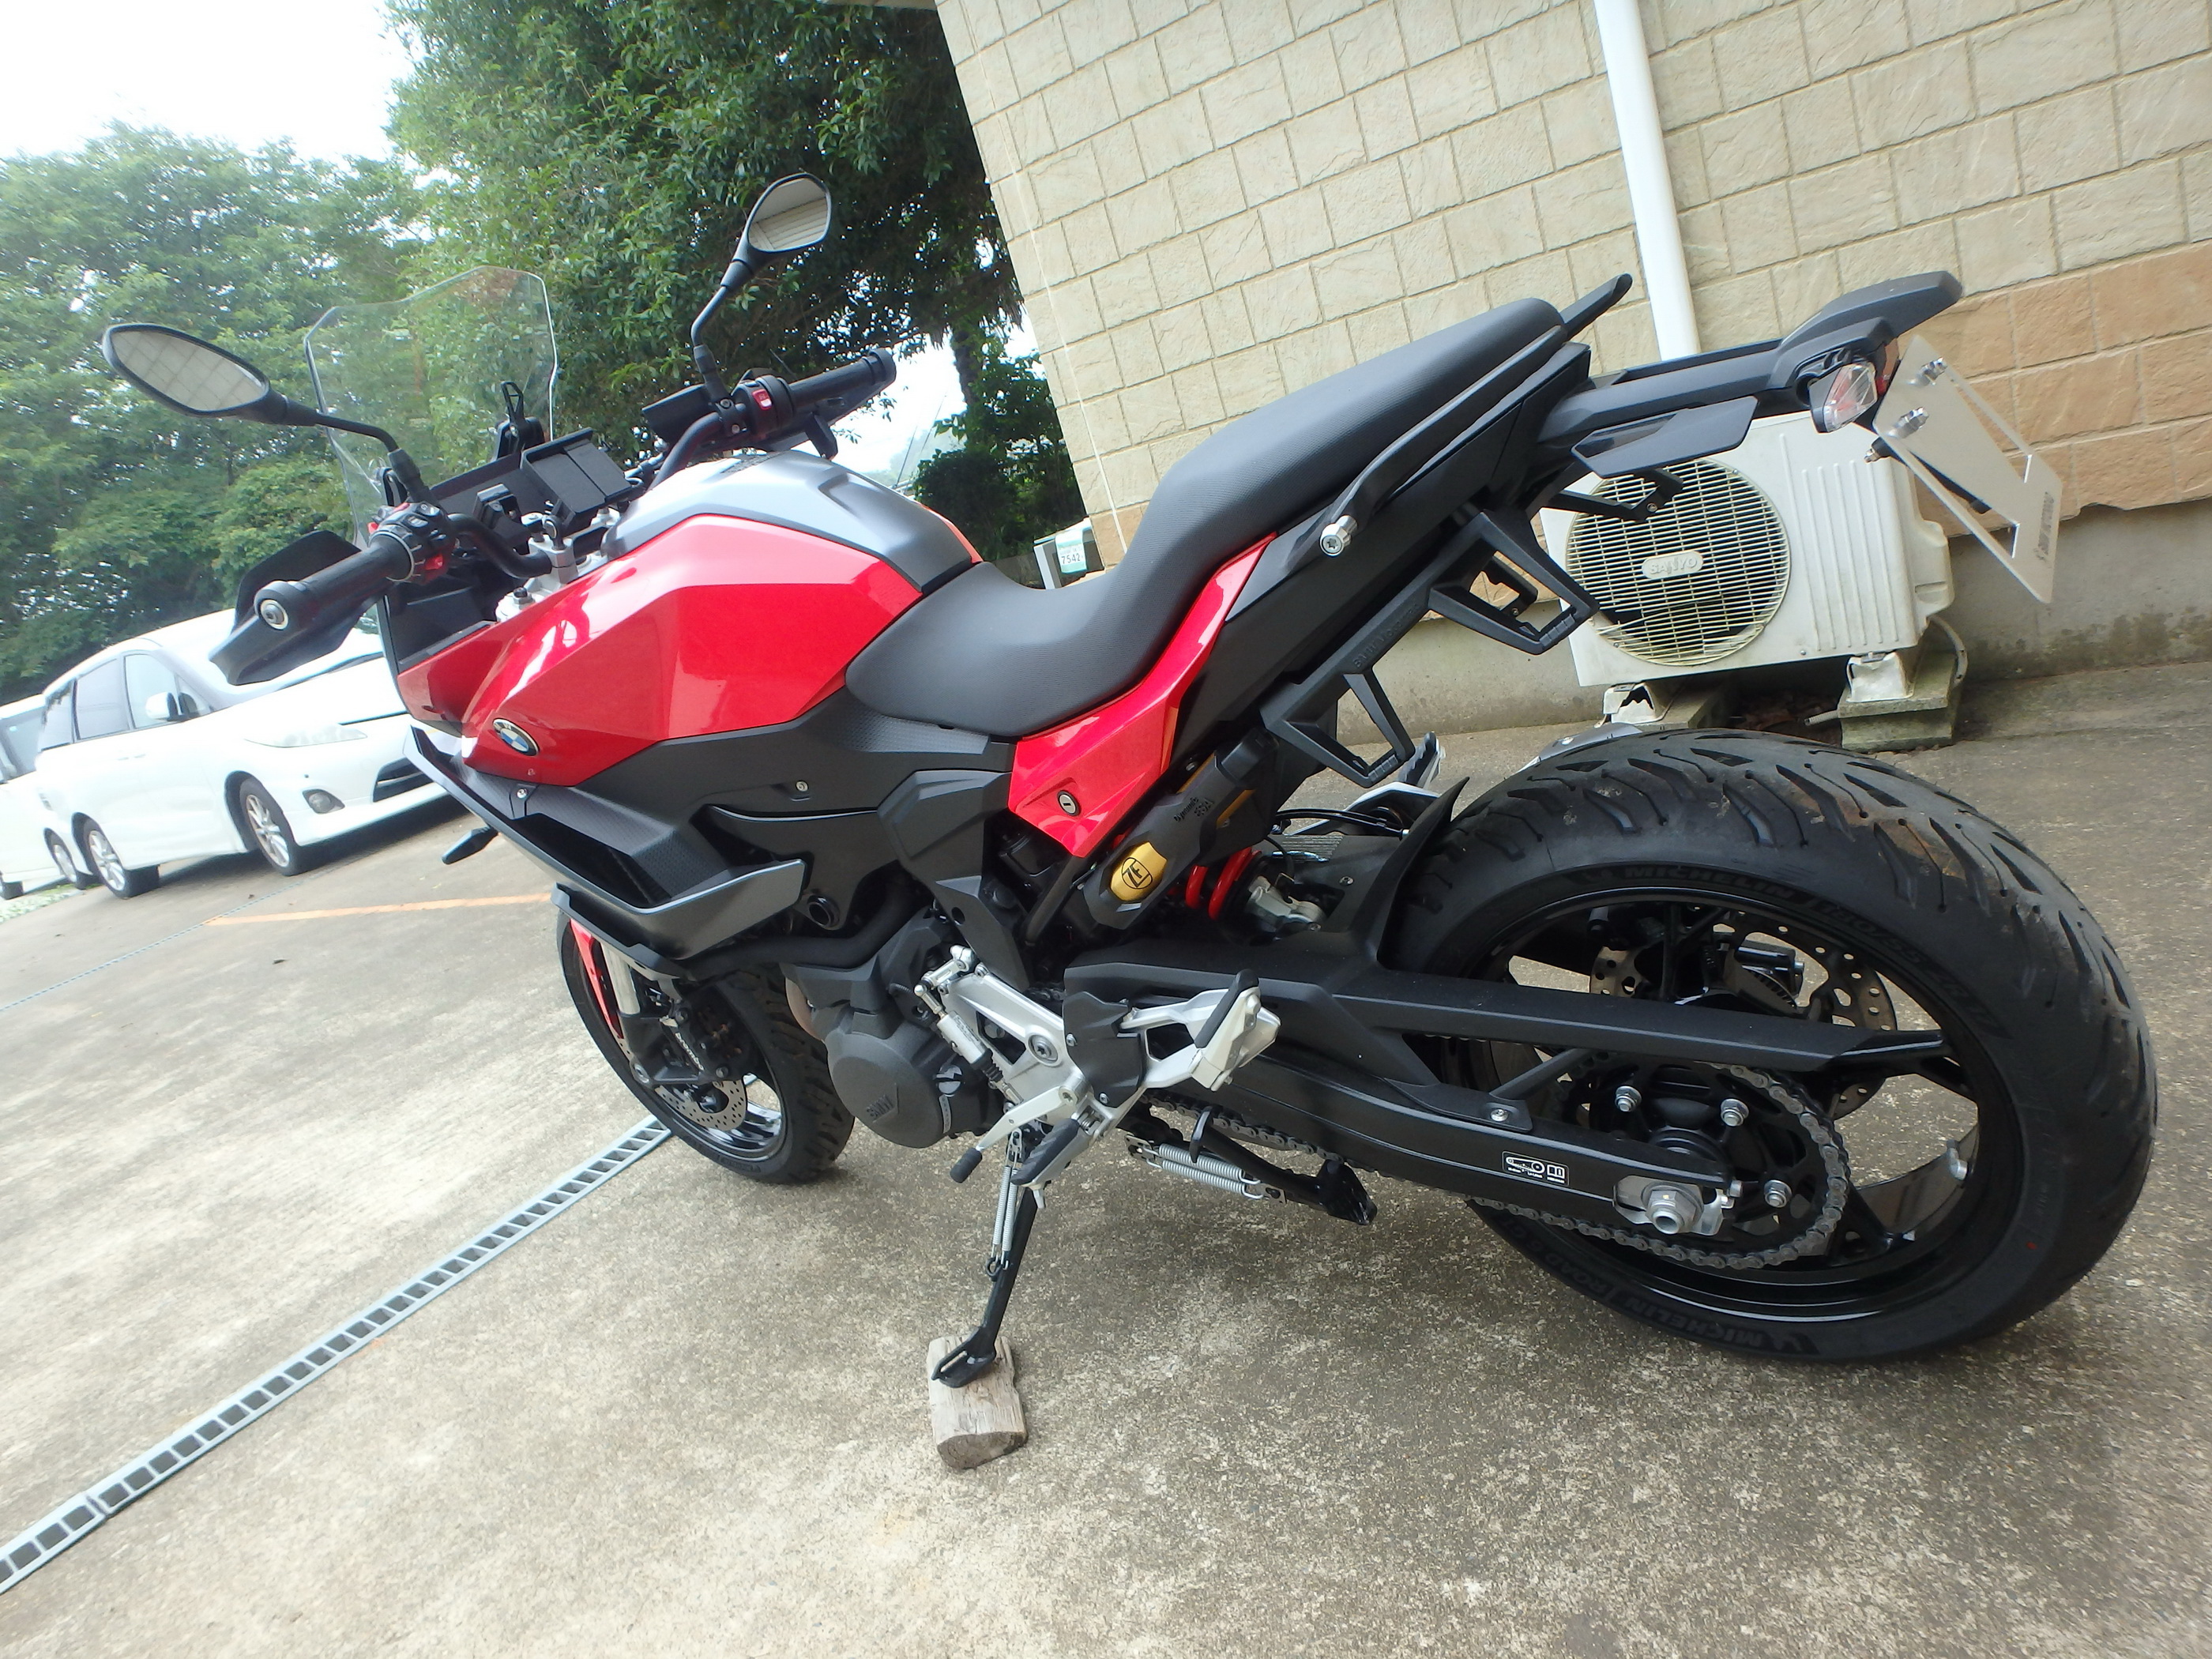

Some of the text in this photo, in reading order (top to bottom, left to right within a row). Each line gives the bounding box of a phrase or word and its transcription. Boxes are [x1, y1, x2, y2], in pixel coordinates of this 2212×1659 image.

[1061, 552, 1081, 564] 7542
[1650, 555, 1698, 575] SANYO
[1122, 859, 1151, 888] ZF
[1625, 866, 1794, 899] MICHELIN
[675, 1032, 705, 1072] brembo
[1624, 1296, 1762, 1348] MICHELIN
